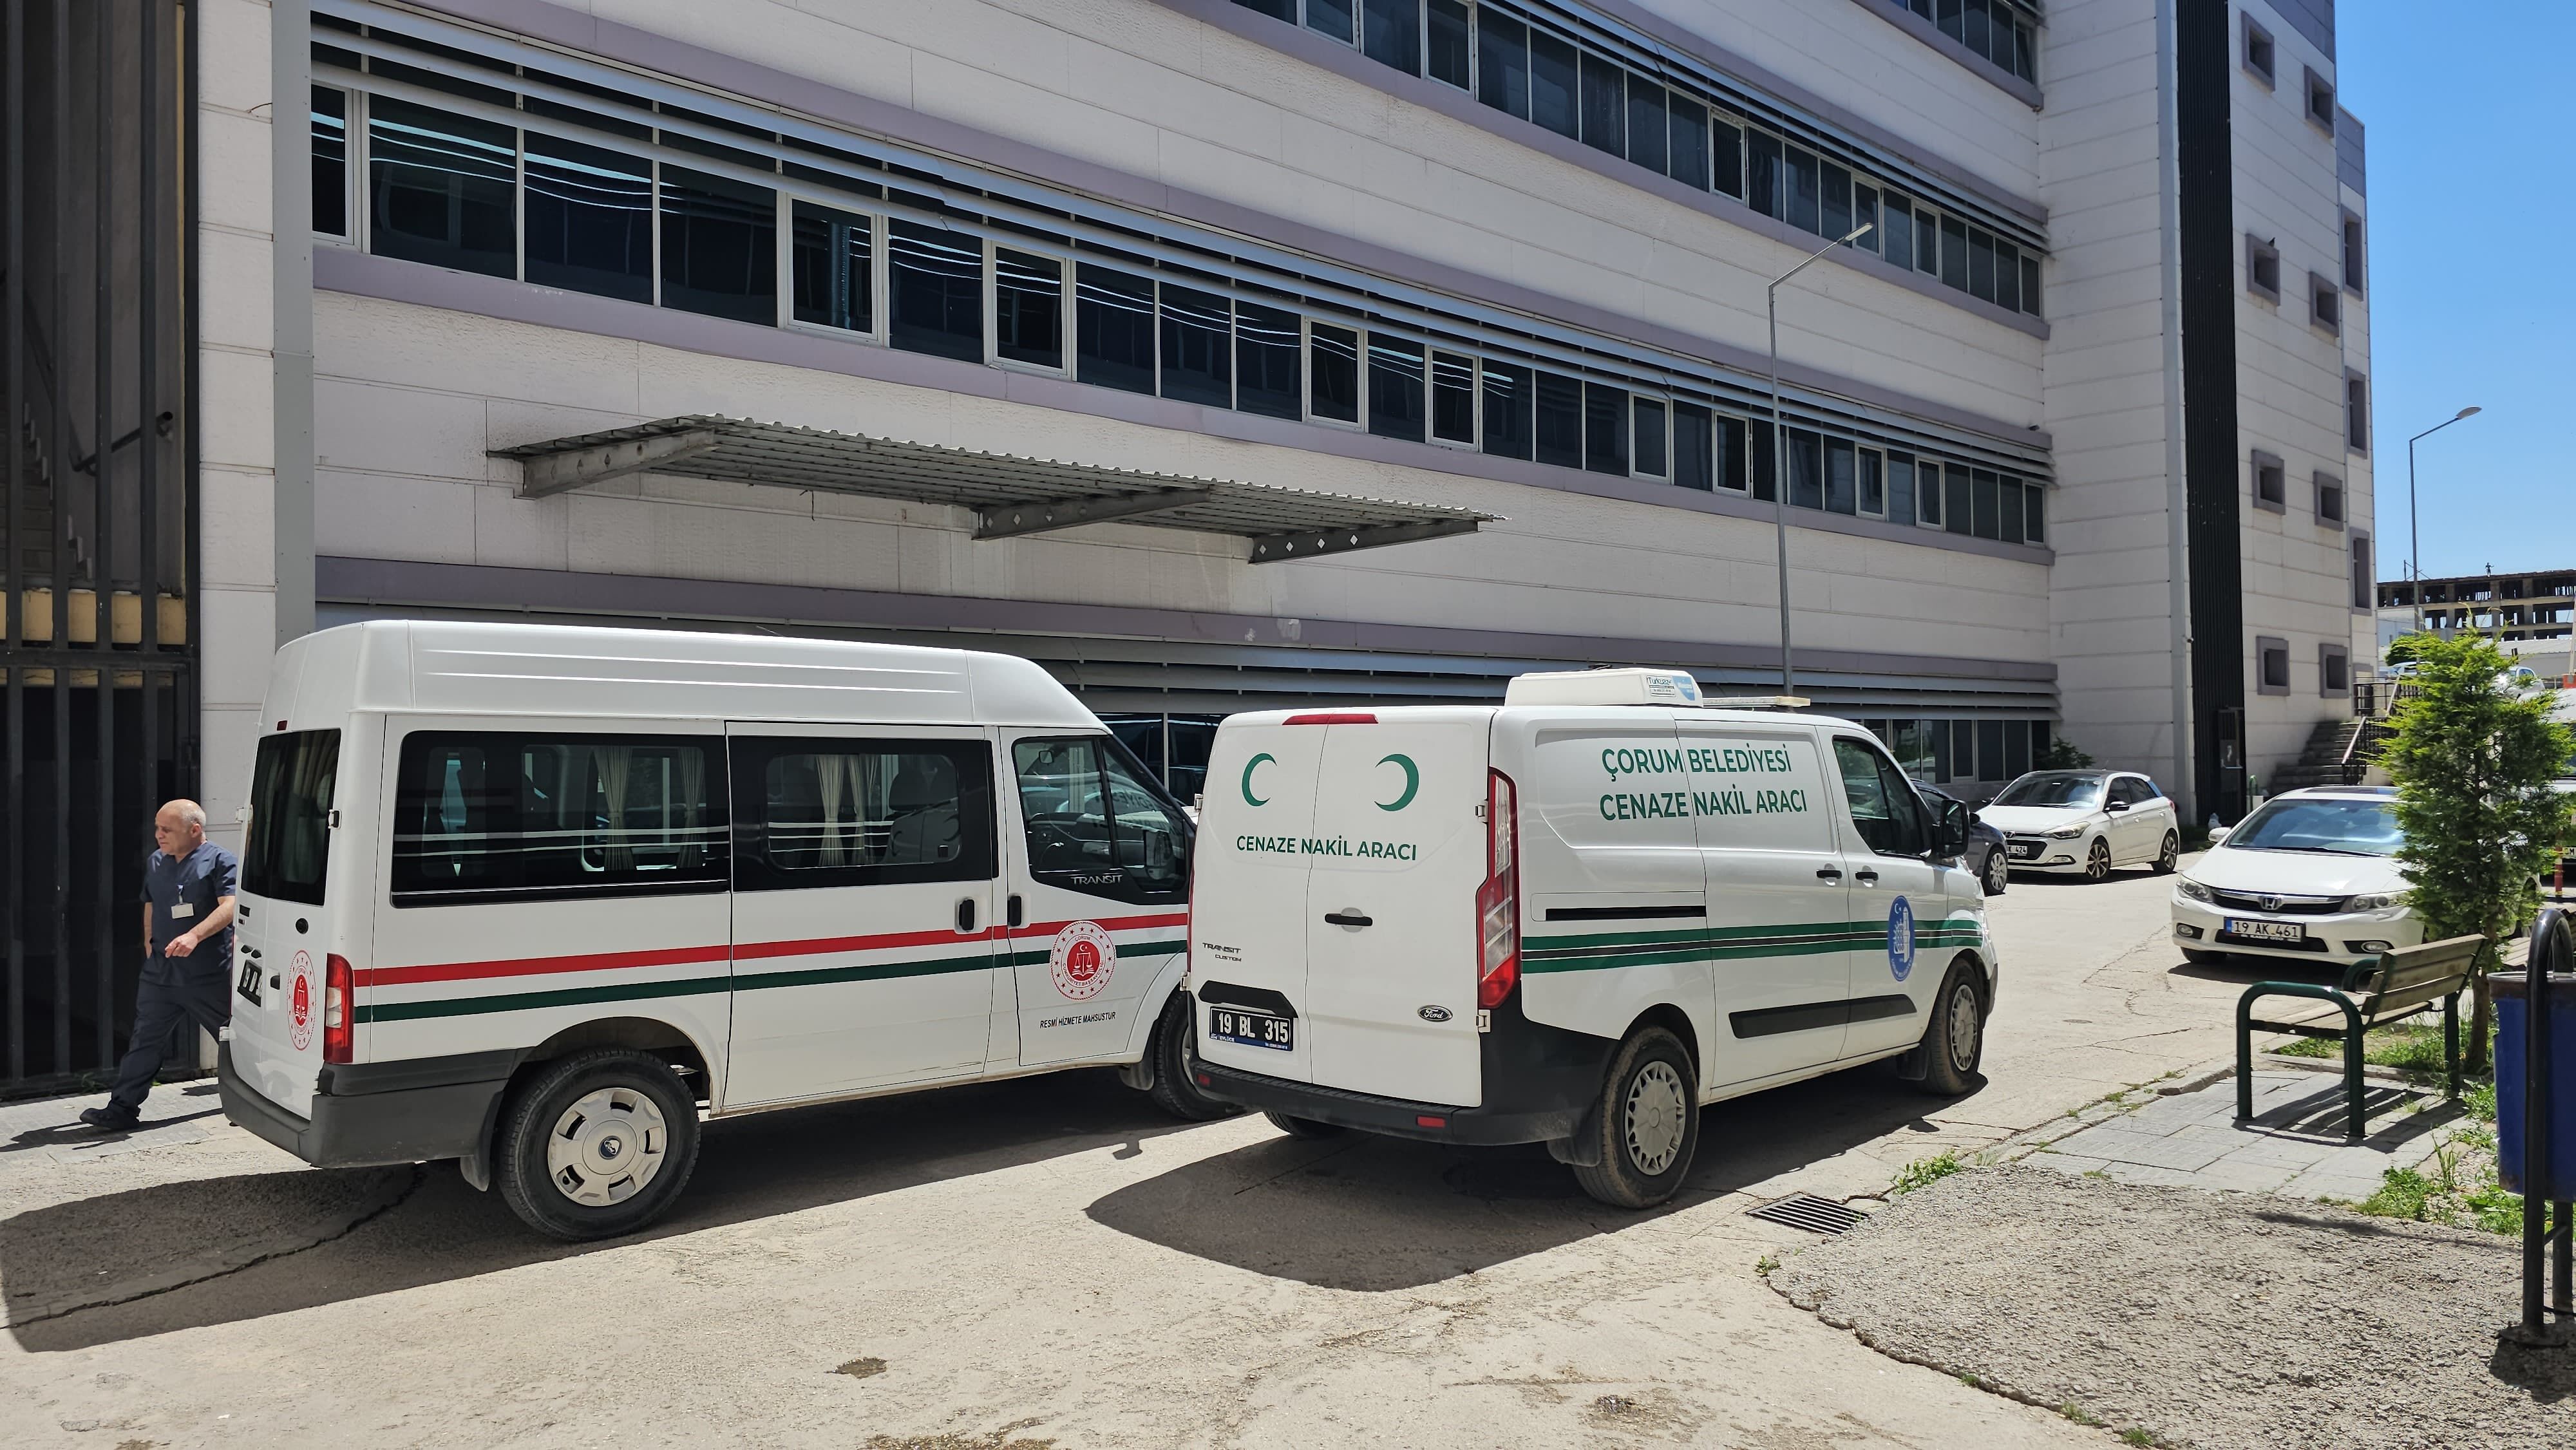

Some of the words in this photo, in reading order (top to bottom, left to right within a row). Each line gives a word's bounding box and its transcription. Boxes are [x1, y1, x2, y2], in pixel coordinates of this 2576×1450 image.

[1602, 748, 1684, 782] ÇORUM
[1687, 742, 1792, 773] BELEDİYESİ
[1600, 792, 1689, 821] CENAZE
[1692, 784, 1752, 816] NAKİL
[1756, 789, 1807, 814] ARACI
[1236, 835, 1296, 854] CENAZE
[1301, 834, 1353, 856] NAKİL
[1357, 841, 1417, 861] ARACI
[1070, 874, 1123, 885] TRANSIT
[2234, 921, 2249, 933] 19
[2255, 923, 2269, 935] AK
[2275, 925, 2298, 937] 461
[1202, 942, 1242, 954] TRANSIT
[1039, 1017, 1058, 1029] RESMİ
[1058, 1015, 1082, 1026] HİZMETE
[1083, 1012, 1116, 1023] MAHSUSTUR
[1424, 1008, 1444, 1018] Ford
[1218, 1013, 1232, 1034] 19
[1239, 1015, 1256, 1038] BL
[1265, 1019, 1289, 1043] 315
